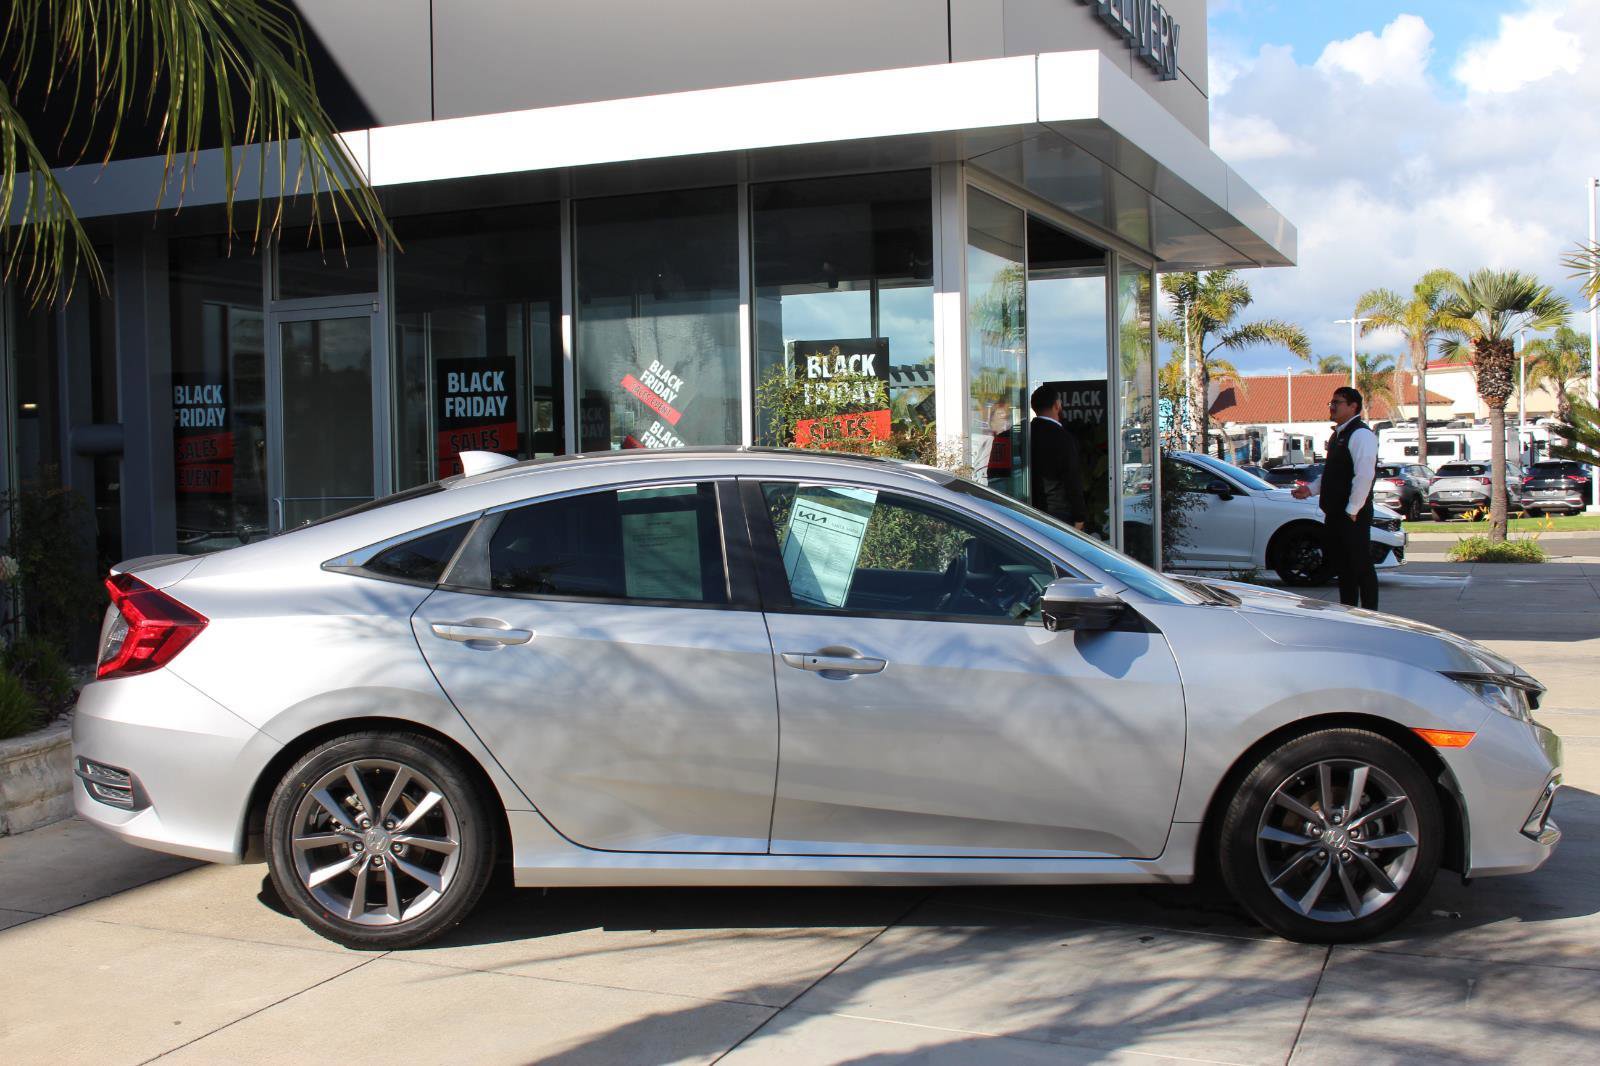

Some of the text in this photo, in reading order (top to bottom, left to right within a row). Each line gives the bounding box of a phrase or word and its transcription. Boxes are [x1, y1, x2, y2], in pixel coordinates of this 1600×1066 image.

[649, 359, 684, 393] BLACK
[805, 353, 876, 379] BLACK
[447, 371, 505, 393] BLACK
[640, 369, 678, 404] FRIDAY
[174, 384, 223, 405] BLACK
[445, 396, 508, 418] FRIDAY
[450, 430, 499, 453] SALES
[798, 510, 827, 523] KIA
